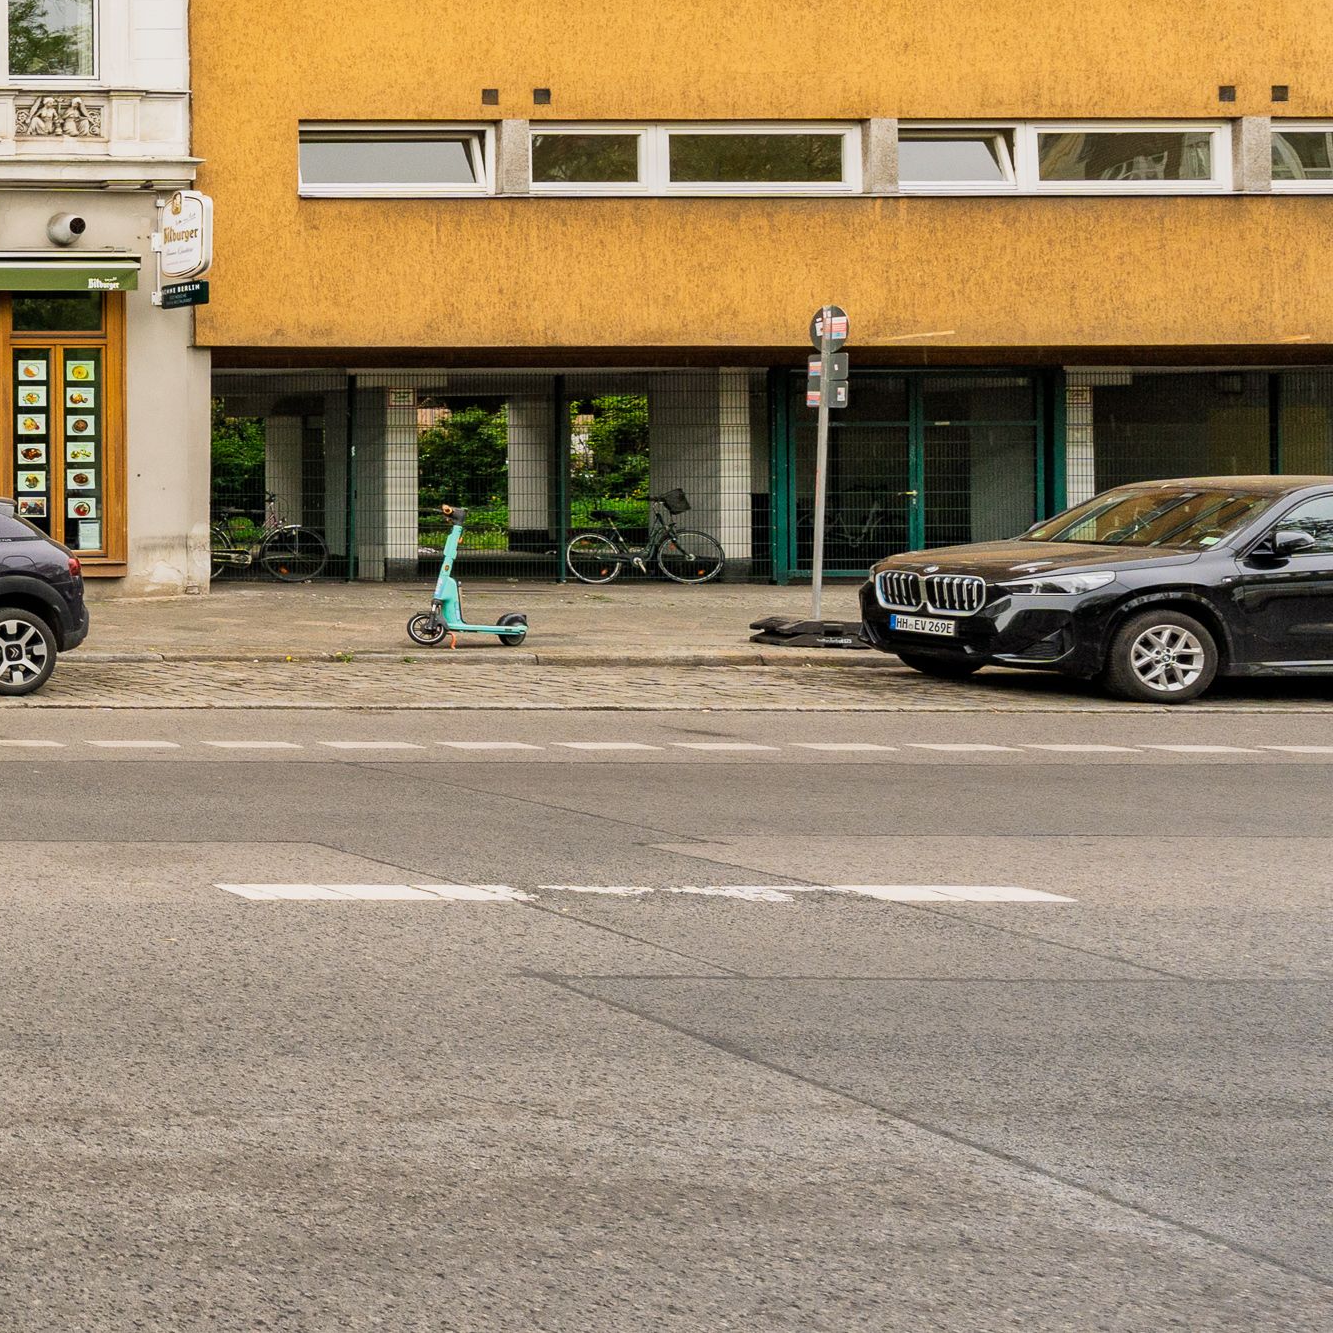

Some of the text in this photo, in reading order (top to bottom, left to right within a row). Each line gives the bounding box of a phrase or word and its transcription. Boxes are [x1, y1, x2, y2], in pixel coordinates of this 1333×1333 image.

[896, 617, 953, 634] HH EV 269E
